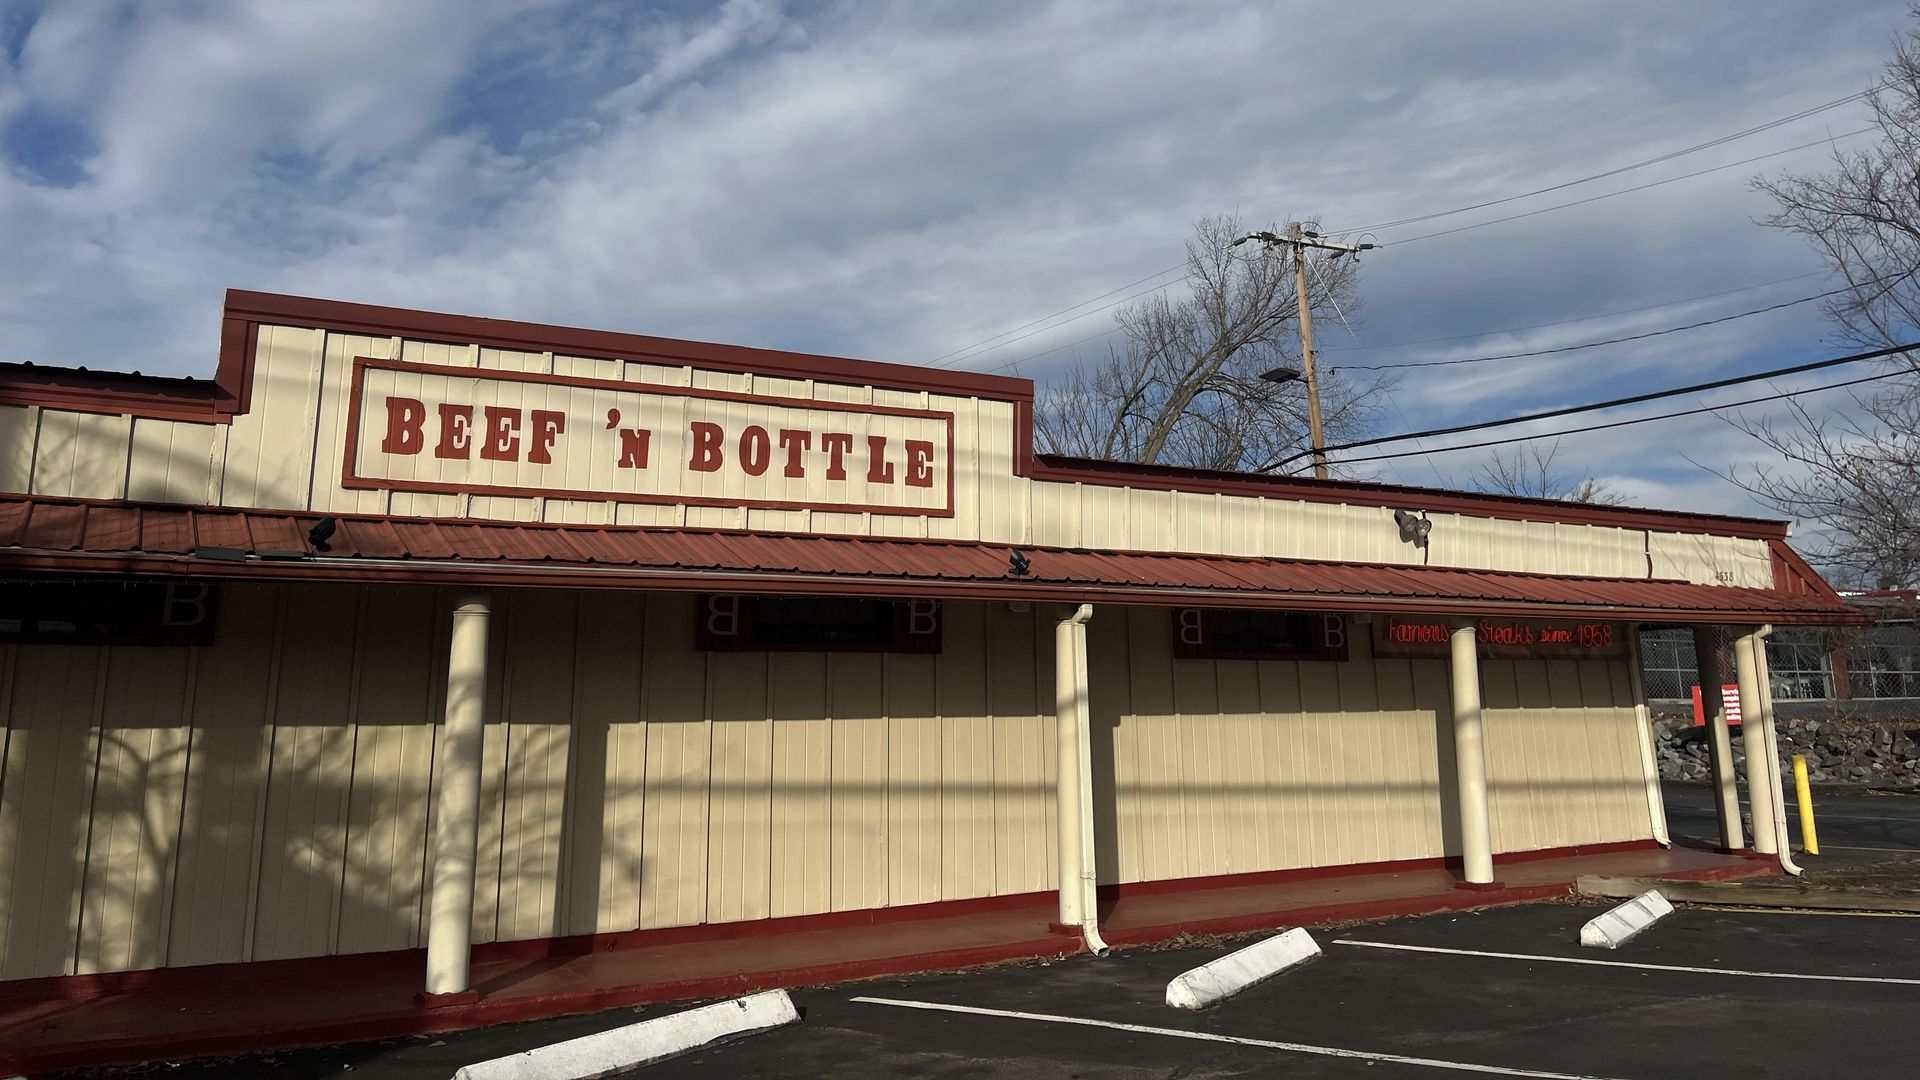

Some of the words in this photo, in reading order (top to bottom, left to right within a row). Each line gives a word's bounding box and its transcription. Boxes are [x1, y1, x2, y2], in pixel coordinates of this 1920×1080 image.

[381, 397, 564, 465] BEEF
[689, 421, 935, 488] BOTTLE
[909, 598, 937, 634] B
[1323, 613, 1345, 648] B
[1388, 616, 1449, 643] Famous
[1479, 618, 1534, 646] Steaks
[1540, 624, 1573, 644] since
[1576, 623, 1613, 648] 1958
